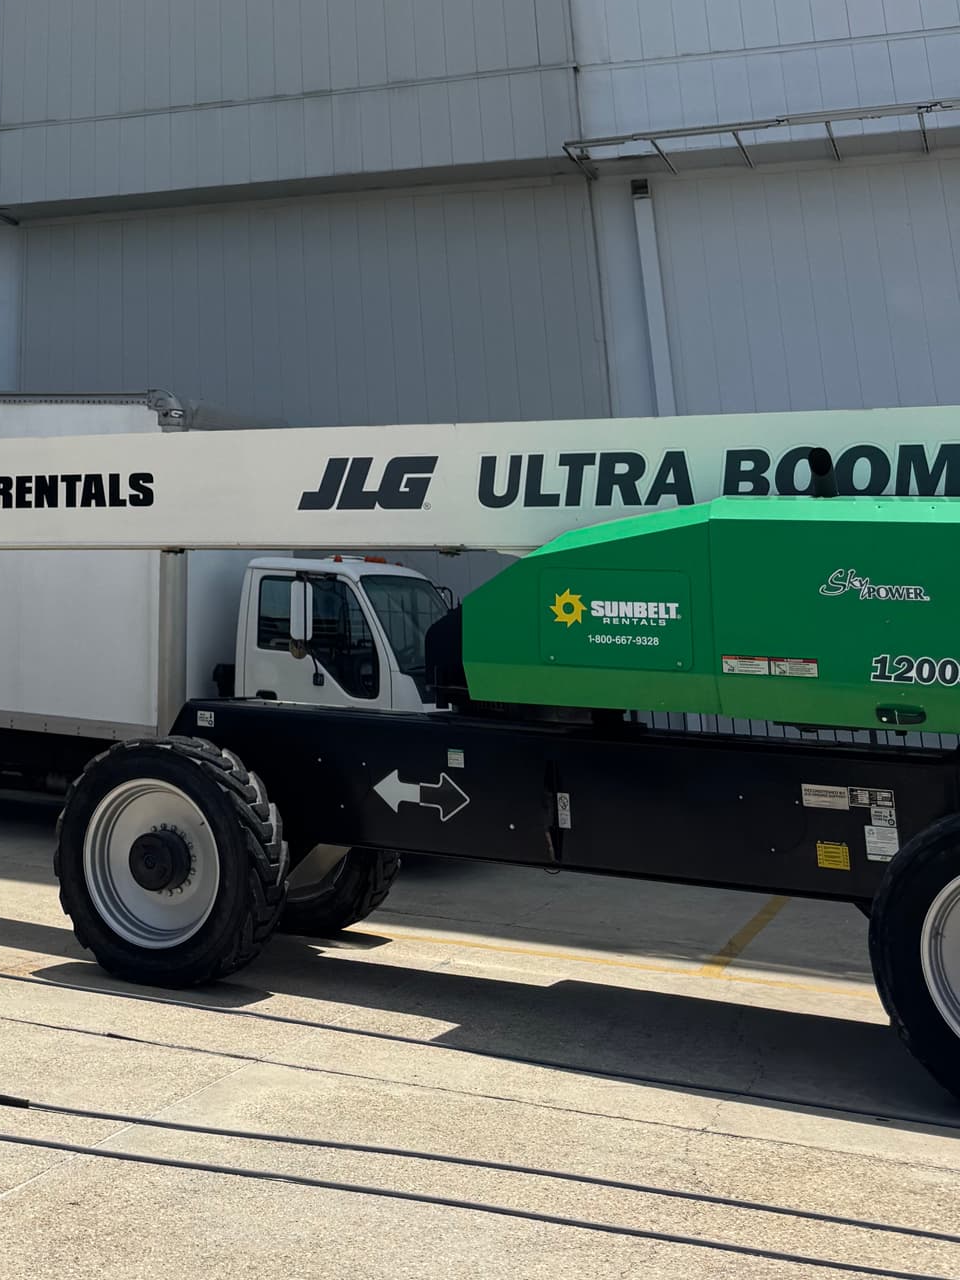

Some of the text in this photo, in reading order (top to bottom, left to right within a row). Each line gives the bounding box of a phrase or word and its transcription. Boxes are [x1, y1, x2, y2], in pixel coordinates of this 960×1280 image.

[297, 455, 439, 511] JLG
[477, 449, 695, 509] ULTRA
[590, 600, 679, 619] SUNBELT
[602, 617, 666, 626] RENTALS
[587, 634, 659, 646] 1-800-667-9328
